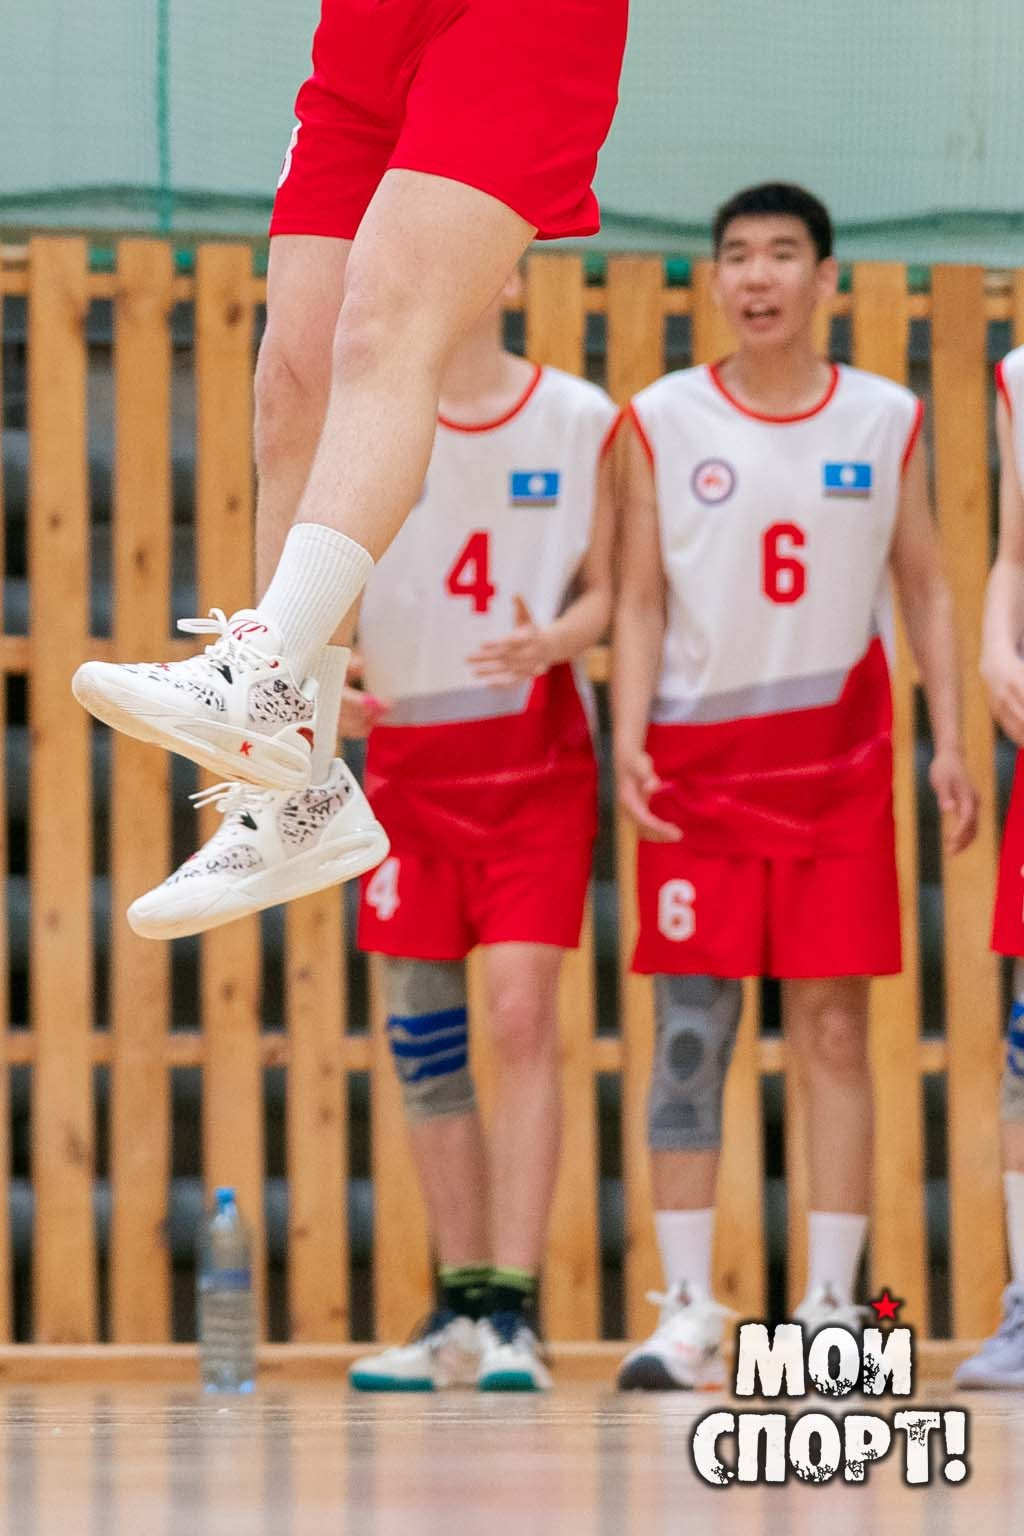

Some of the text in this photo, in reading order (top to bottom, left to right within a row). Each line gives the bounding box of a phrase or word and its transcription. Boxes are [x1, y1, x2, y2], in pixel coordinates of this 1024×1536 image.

[445, 529, 496, 614] 4
[761, 521, 807, 605] 6
[365, 856, 400, 921] 4
[658, 878, 696, 942] 6
